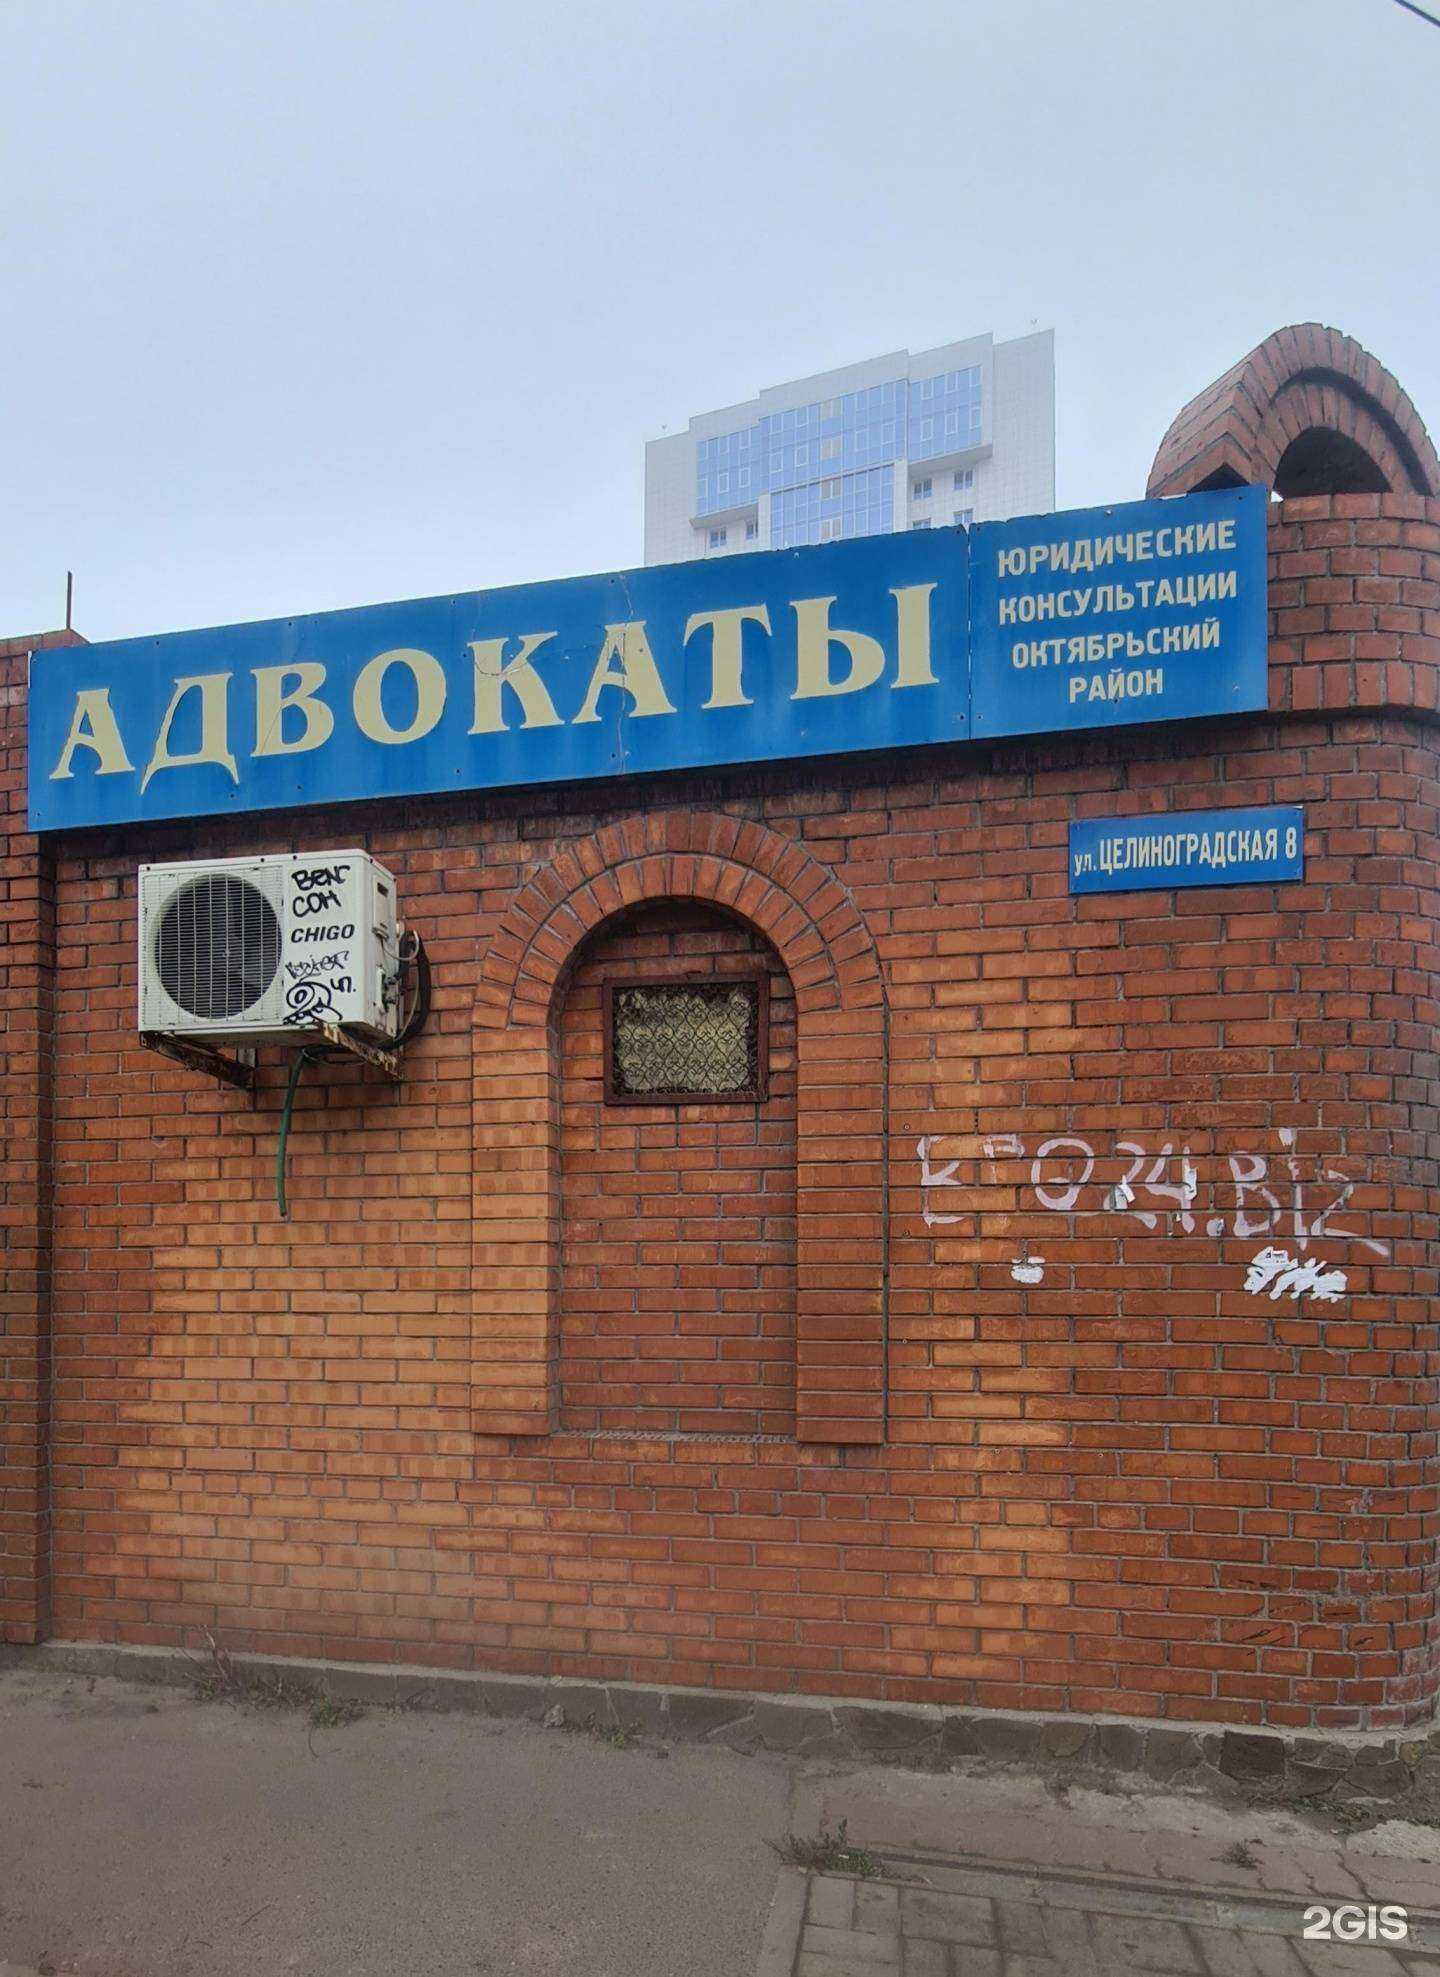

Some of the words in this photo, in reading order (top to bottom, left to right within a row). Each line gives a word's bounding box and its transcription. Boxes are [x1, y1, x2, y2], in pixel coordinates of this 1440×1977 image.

[998, 519, 1237, 578] ЮРИДИЧЕСКИЕ
[998, 570, 1238, 626] КОНСУЛЬТАЦИИ
[1012, 617, 1220, 669] ОКТЯБРЬСКИЙ
[48, 581, 940, 796] АДВОКАТЫ
[1069, 667, 1164, 704] РАЙОН
[1074, 852, 1097, 877] ул.
[1099, 828, 1278, 876] ЦЕЛИНОГРАДСКАЯ
[1285, 826, 1298, 860] 8
[291, 923, 356, 944] CHIGO
